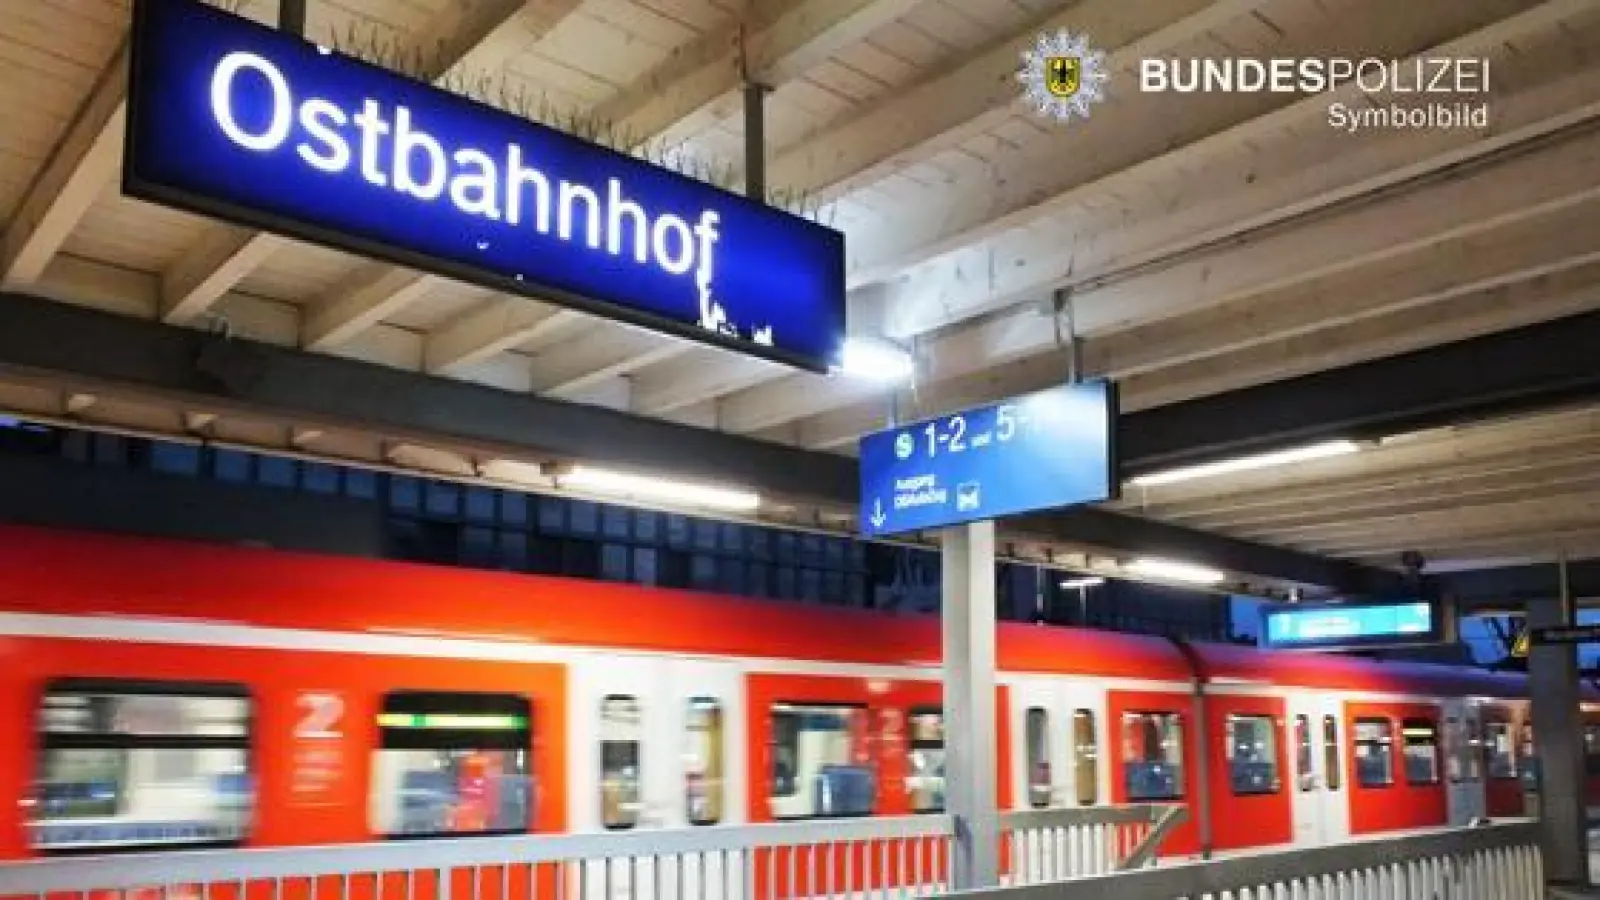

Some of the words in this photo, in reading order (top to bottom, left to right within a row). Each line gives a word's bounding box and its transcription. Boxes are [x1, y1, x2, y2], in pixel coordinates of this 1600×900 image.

[210, 52, 720, 284] Ostbahnhof
[925, 416, 967, 458] 1-2
[292, 693, 343, 738] 2
